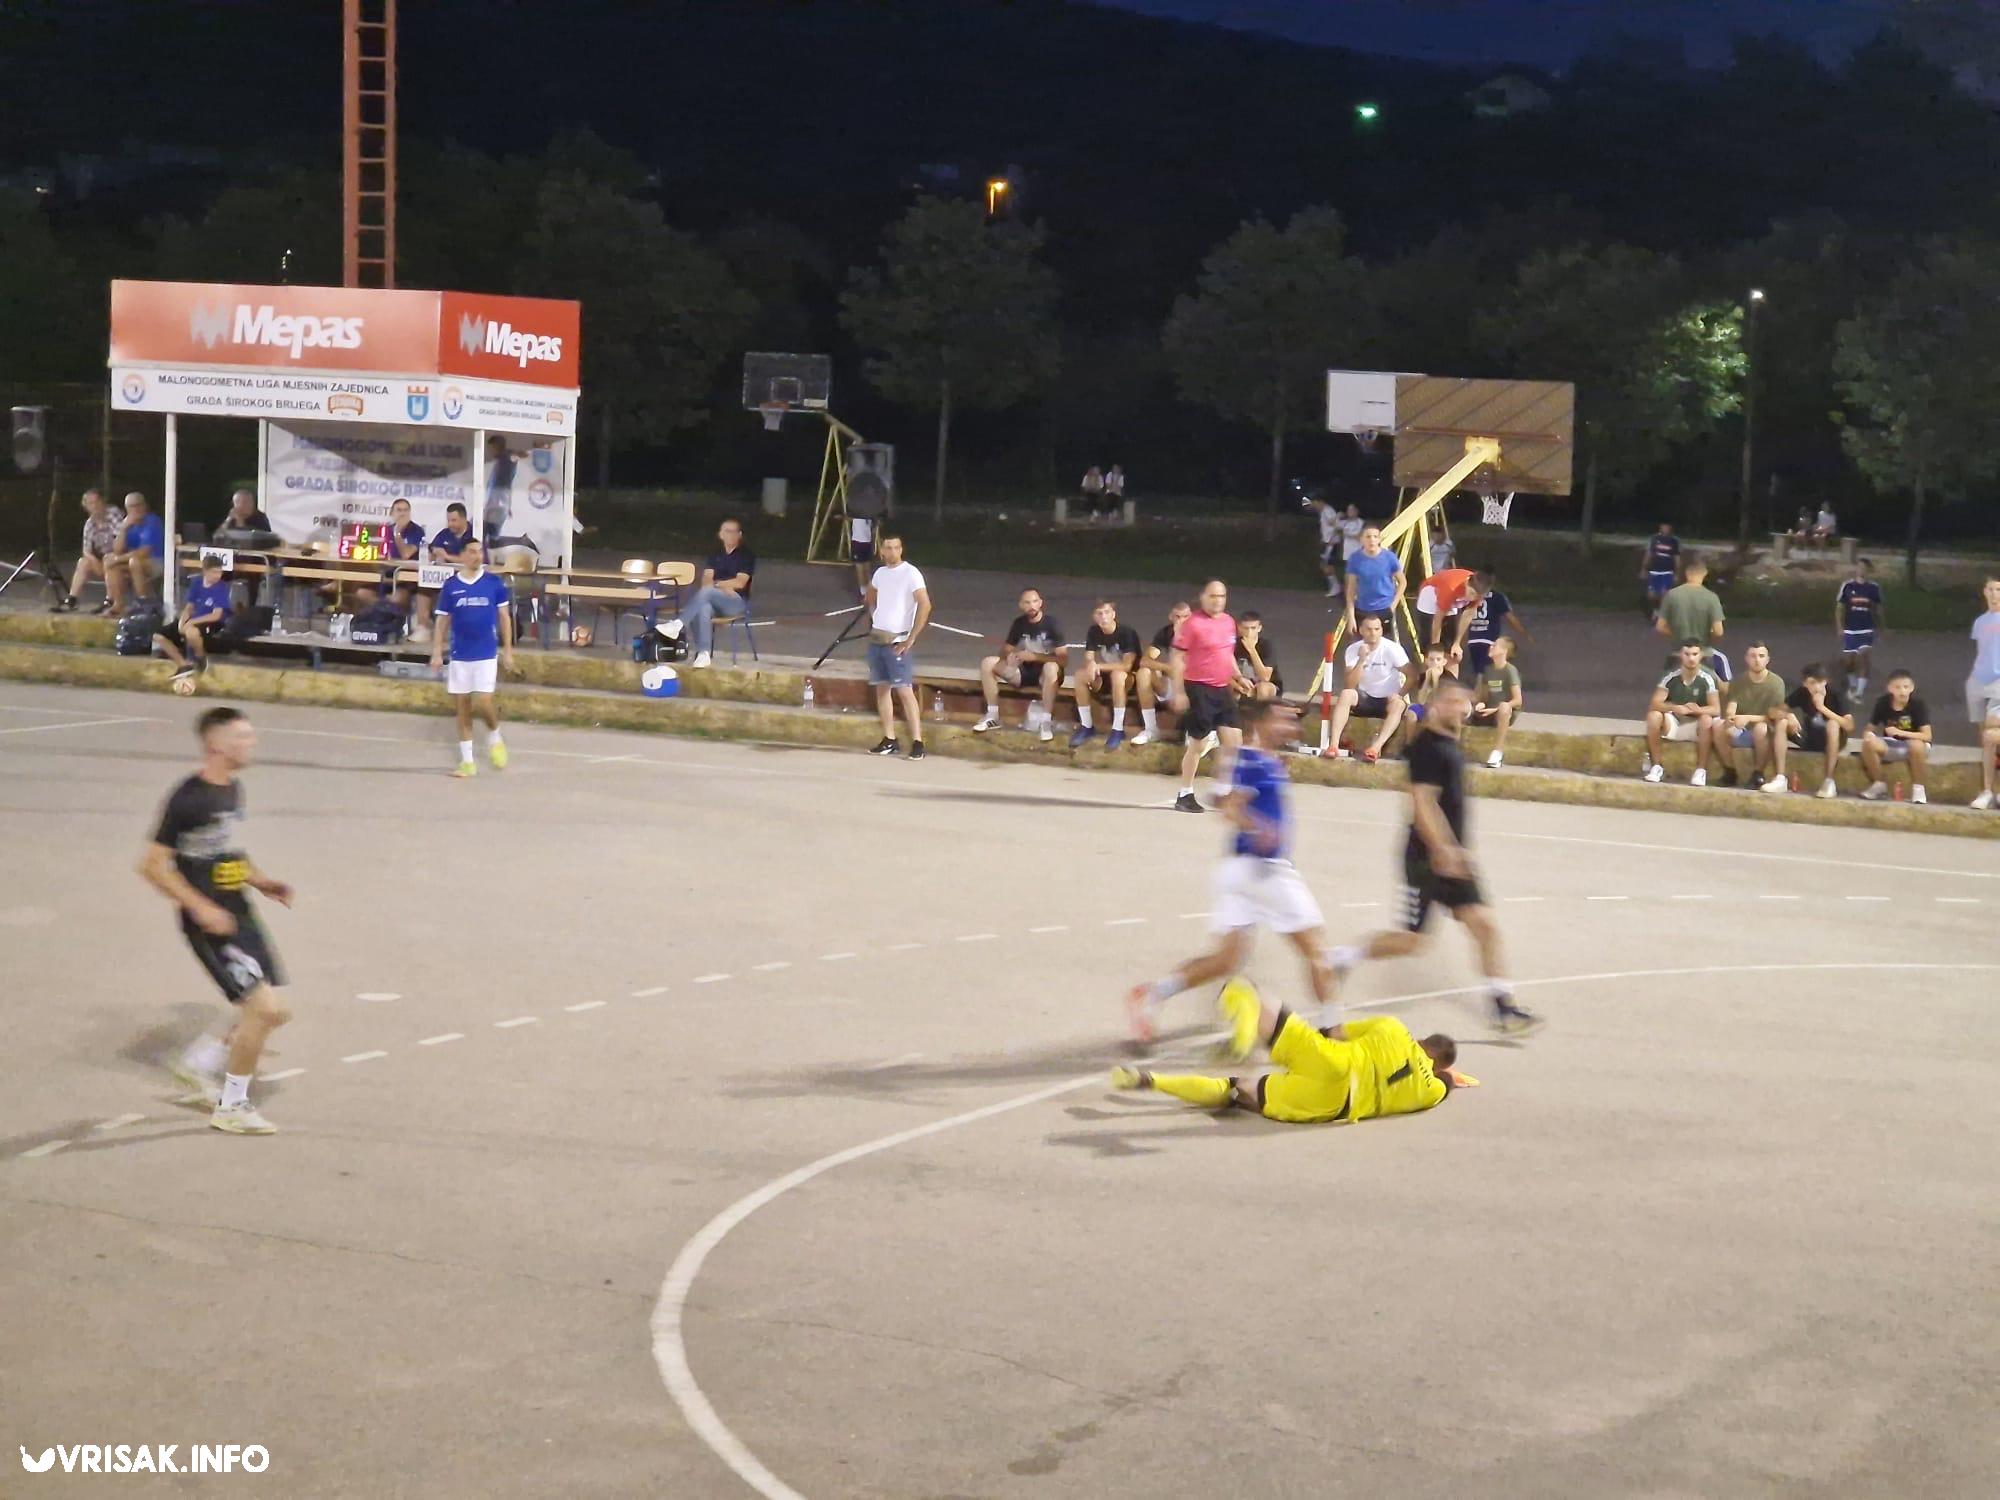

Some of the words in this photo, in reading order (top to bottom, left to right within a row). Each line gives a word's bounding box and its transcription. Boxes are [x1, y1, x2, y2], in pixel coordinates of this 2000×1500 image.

[232, 304, 364, 359] Mepas
[485, 320, 562, 368] Mepas
[158, 374, 253, 388] MALONOGOMETNA
[256, 379, 282, 388] LIGA
[330, 382, 389, 395] ZAJEDNICA
[186, 395, 222, 406] GRADA
[225, 395, 273, 408] ŠIROKOG
[285, 475, 334, 491] GRADA
[404, 483, 466, 500] BRIJEGA
[1387, 1058, 1413, 1086] 1
